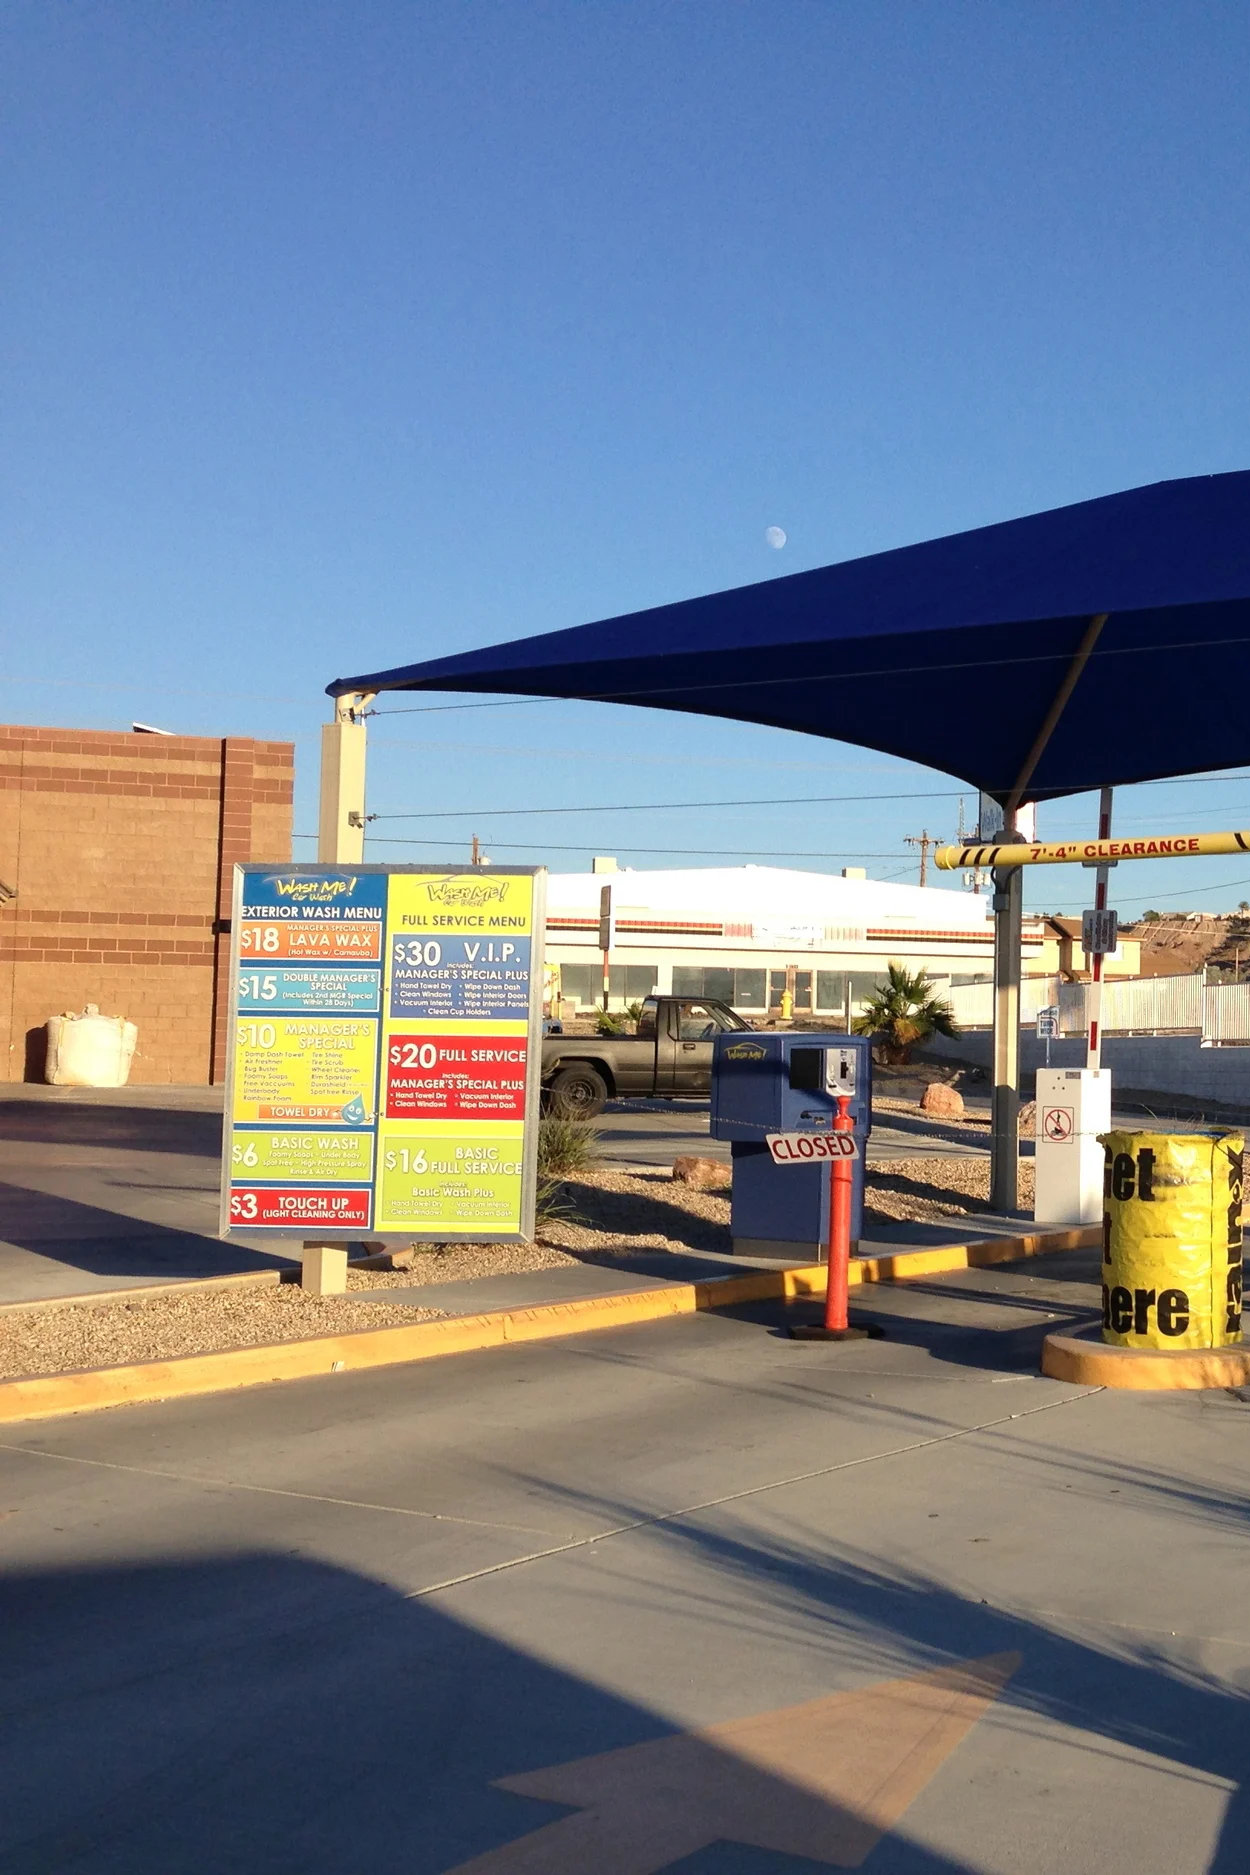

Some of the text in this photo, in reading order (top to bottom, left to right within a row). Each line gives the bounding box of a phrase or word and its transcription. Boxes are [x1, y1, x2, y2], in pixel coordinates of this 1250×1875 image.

[1030, 838, 1200, 861] 7'-4" CLEARANCE
[242, 906, 382, 918] EXTERIOR WASH MENU
[402, 914, 526, 927] FULL SERVICE MENU
[240, 927, 280, 952] $18
[290, 934, 372, 947] LAVA WAX
[394, 940, 441, 967] $30
[464, 942, 521, 963] V.I.P.
[283, 974, 376, 982] DOUBLE MANAGER'S
[395, 970, 528, 980] MANAGER'S SPECIAL PLUS
[239, 976, 278, 1000] $15
[310, 982, 348, 990] SPECIAL
[237, 1024, 276, 1048] $10
[285, 1024, 370, 1036] MANAGER'S
[298, 1038, 356, 1050] SPECIAL
[390, 1043, 437, 1069] $20
[440, 1050, 526, 1062] FULL SERVICE
[390, 1079, 524, 1090] MANAGER'S SPECIAL PLUS
[271, 1107, 330, 1117] TOWEL DRY
[272, 1138, 359, 1150] BASIC WASH
[772, 1135, 856, 1160] CLOSED
[232, 1142, 258, 1166] $6
[456, 1148, 498, 1160] BASIC
[385, 1148, 428, 1174] $16
[430, 1162, 522, 1175] FULL SERVICE
[412, 1188, 494, 1198] Basic Wash Plus
[230, 1194, 258, 1219] $3
[278, 1197, 350, 1210] TOUCH UP
[262, 1209, 365, 1220] (LIGHT CLEANING ONLY)
